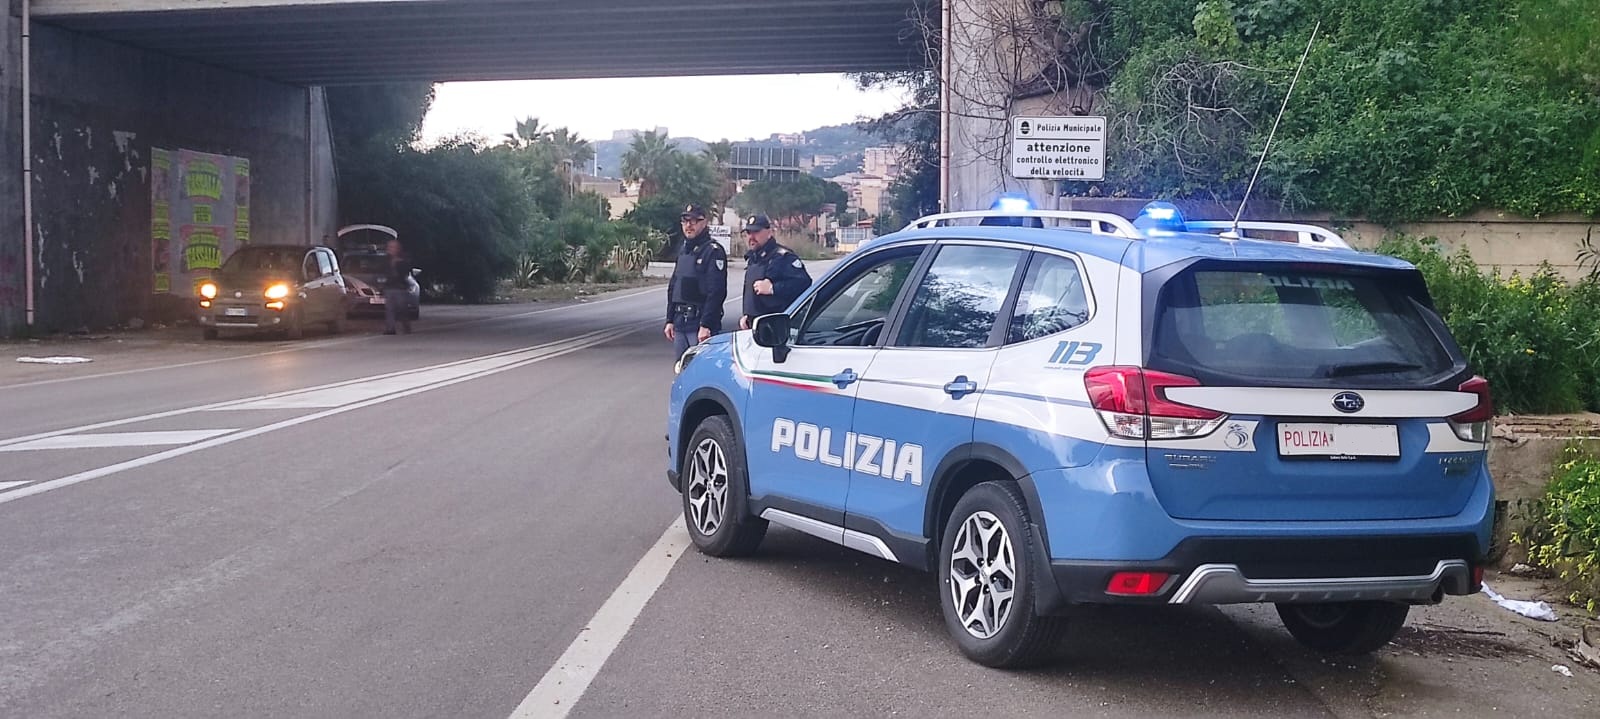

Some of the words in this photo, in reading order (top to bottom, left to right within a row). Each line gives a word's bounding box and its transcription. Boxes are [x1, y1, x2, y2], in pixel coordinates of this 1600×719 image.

[1037, 123, 1061, 132] Polizia
[1063, 124, 1101, 134] Municipale
[1026, 142, 1091, 153] attenzione
[1016, 155, 1053, 164] controllo
[1054, 156, 1099, 165] elettronico
[1030, 167, 1050, 175] della
[1052, 167, 1085, 176] velocità
[1263, 276, 1355, 291] OLIZIA
[1047, 340, 1103, 366] 113
[1283, 430, 1331, 448] POLIZIA
[770, 416, 924, 487] POLIZIA
